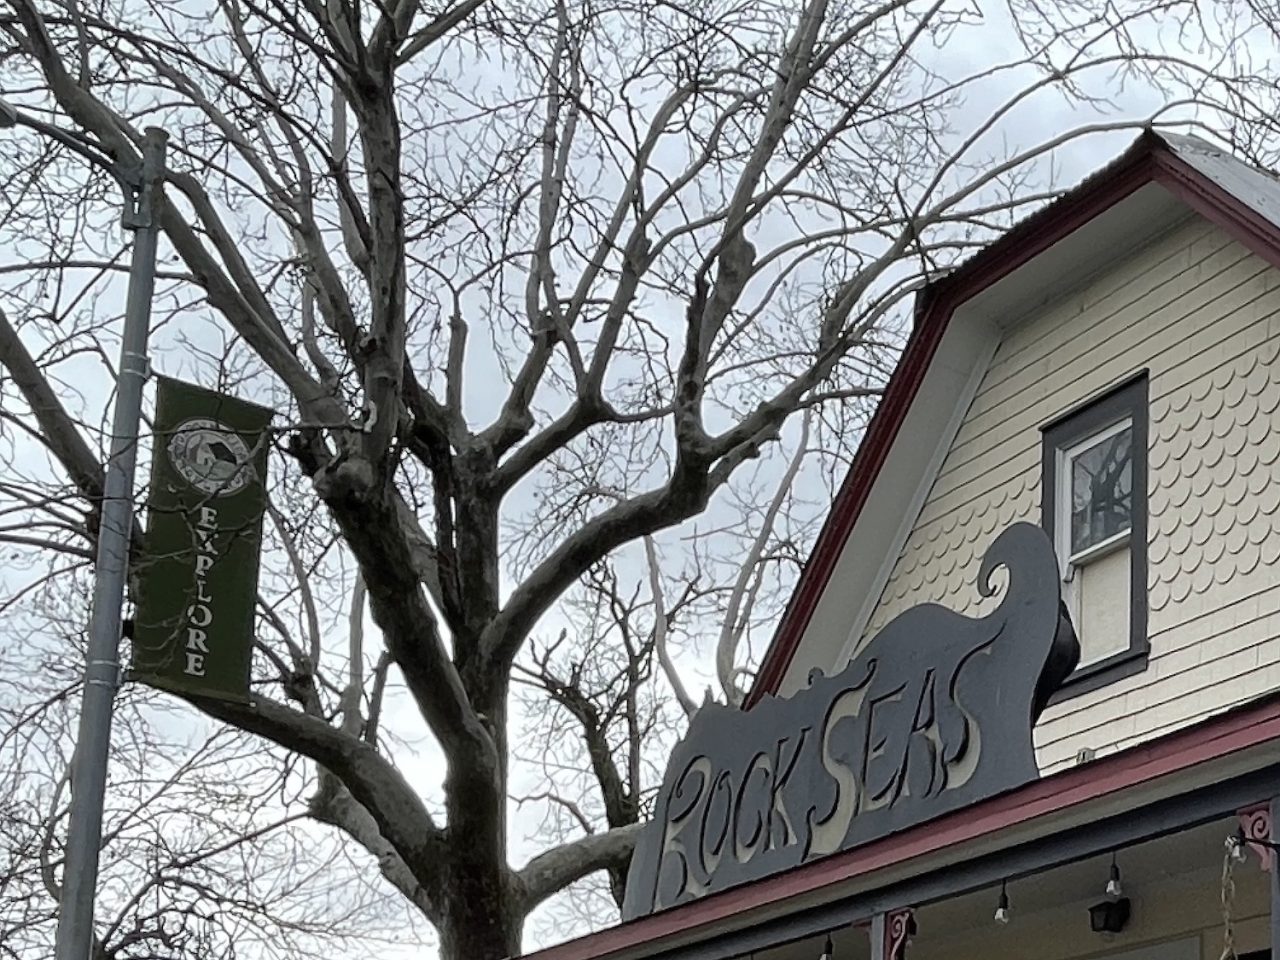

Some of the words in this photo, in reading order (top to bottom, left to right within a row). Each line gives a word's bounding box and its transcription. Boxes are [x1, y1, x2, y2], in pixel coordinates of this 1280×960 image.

[184, 507, 218, 676] EXPLORE
[653, 723, 811, 912] ROCK
[803, 621, 1006, 863] SEAS
